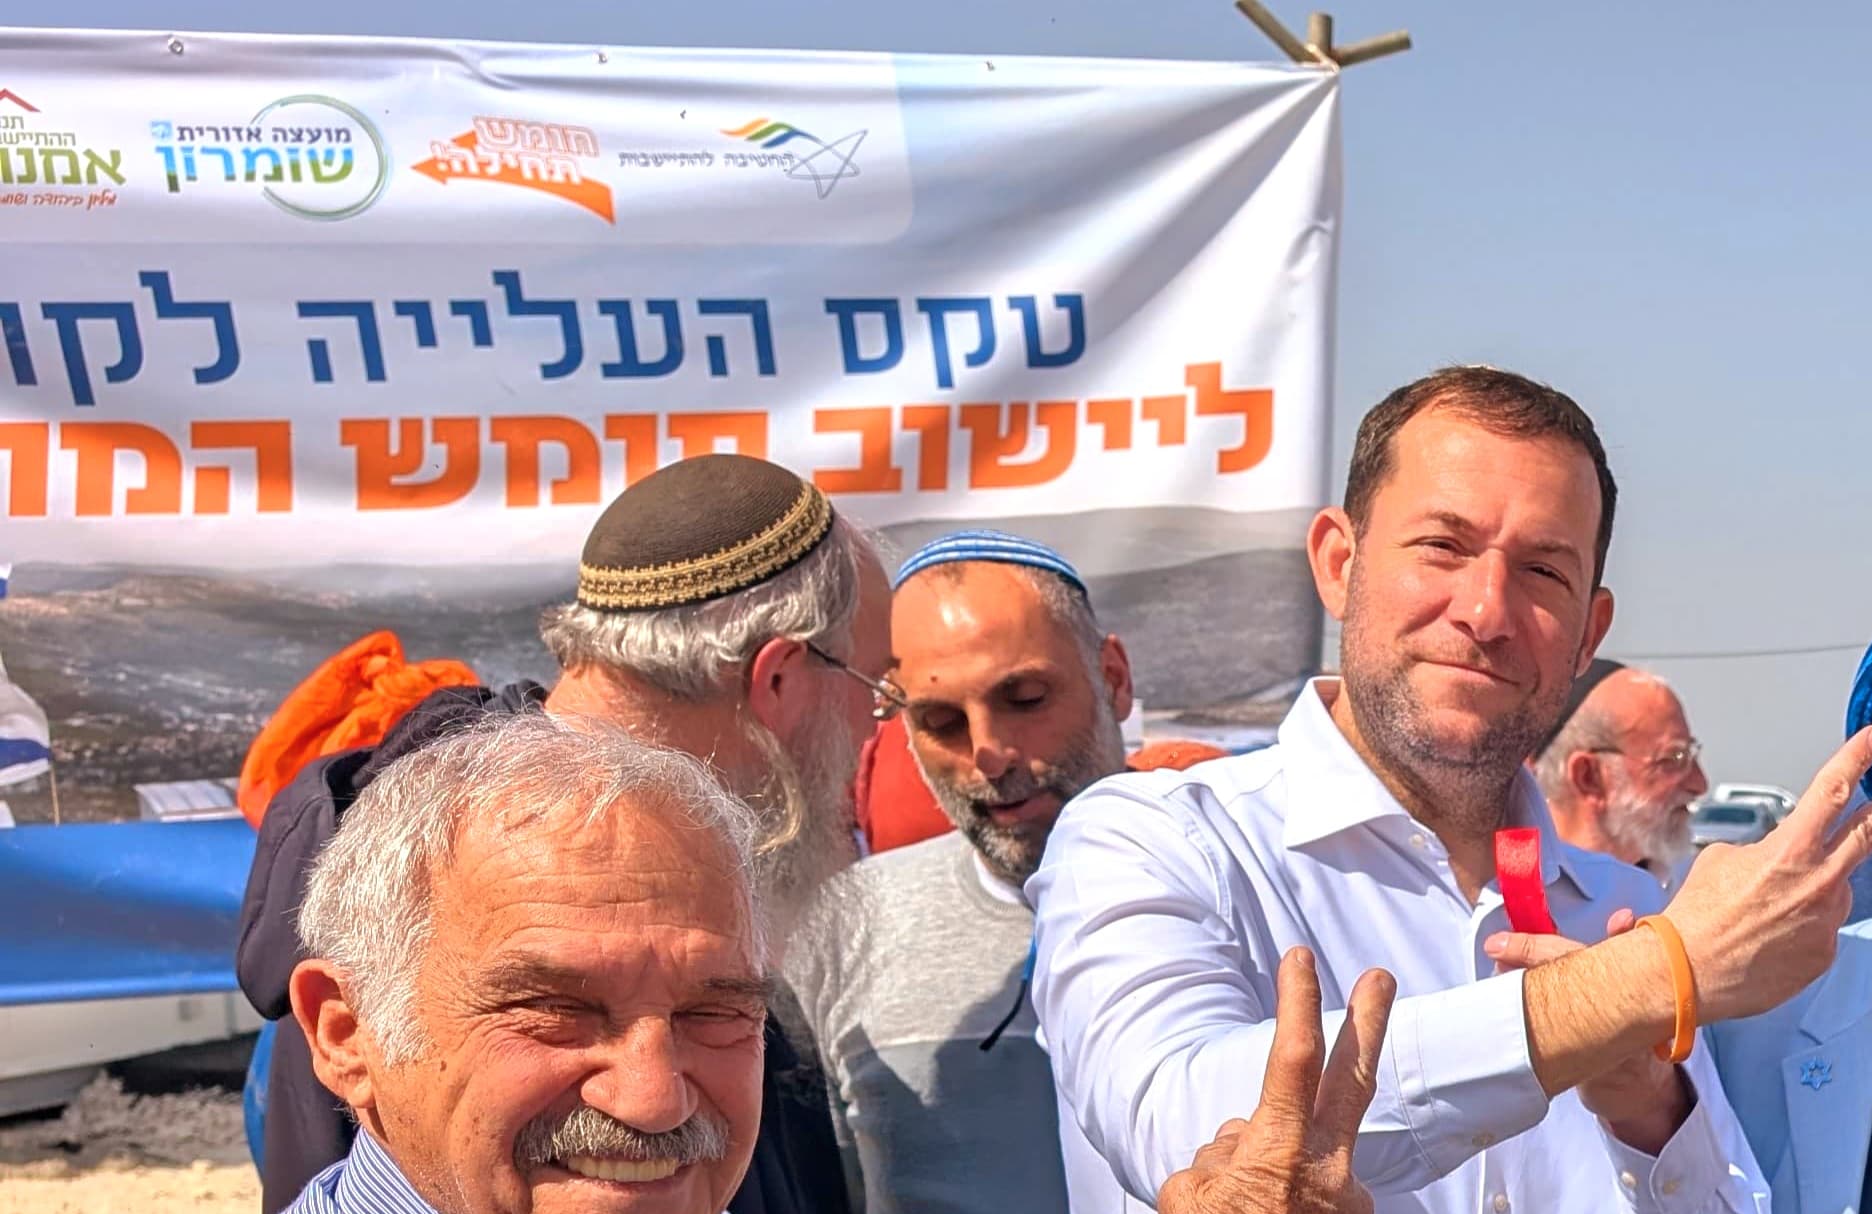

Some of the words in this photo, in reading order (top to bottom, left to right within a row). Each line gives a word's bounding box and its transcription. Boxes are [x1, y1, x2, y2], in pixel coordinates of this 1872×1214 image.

[177, 125, 262, 142] אזורית
[272, 126, 351, 144] מועצה
[472, 116, 600, 157] חומש
[155, 146, 354, 193] שומרון
[297, 270, 777, 384] העלייה
[824, 293, 1087, 389] טקס
[812, 361, 1275, 494] ליישוב
